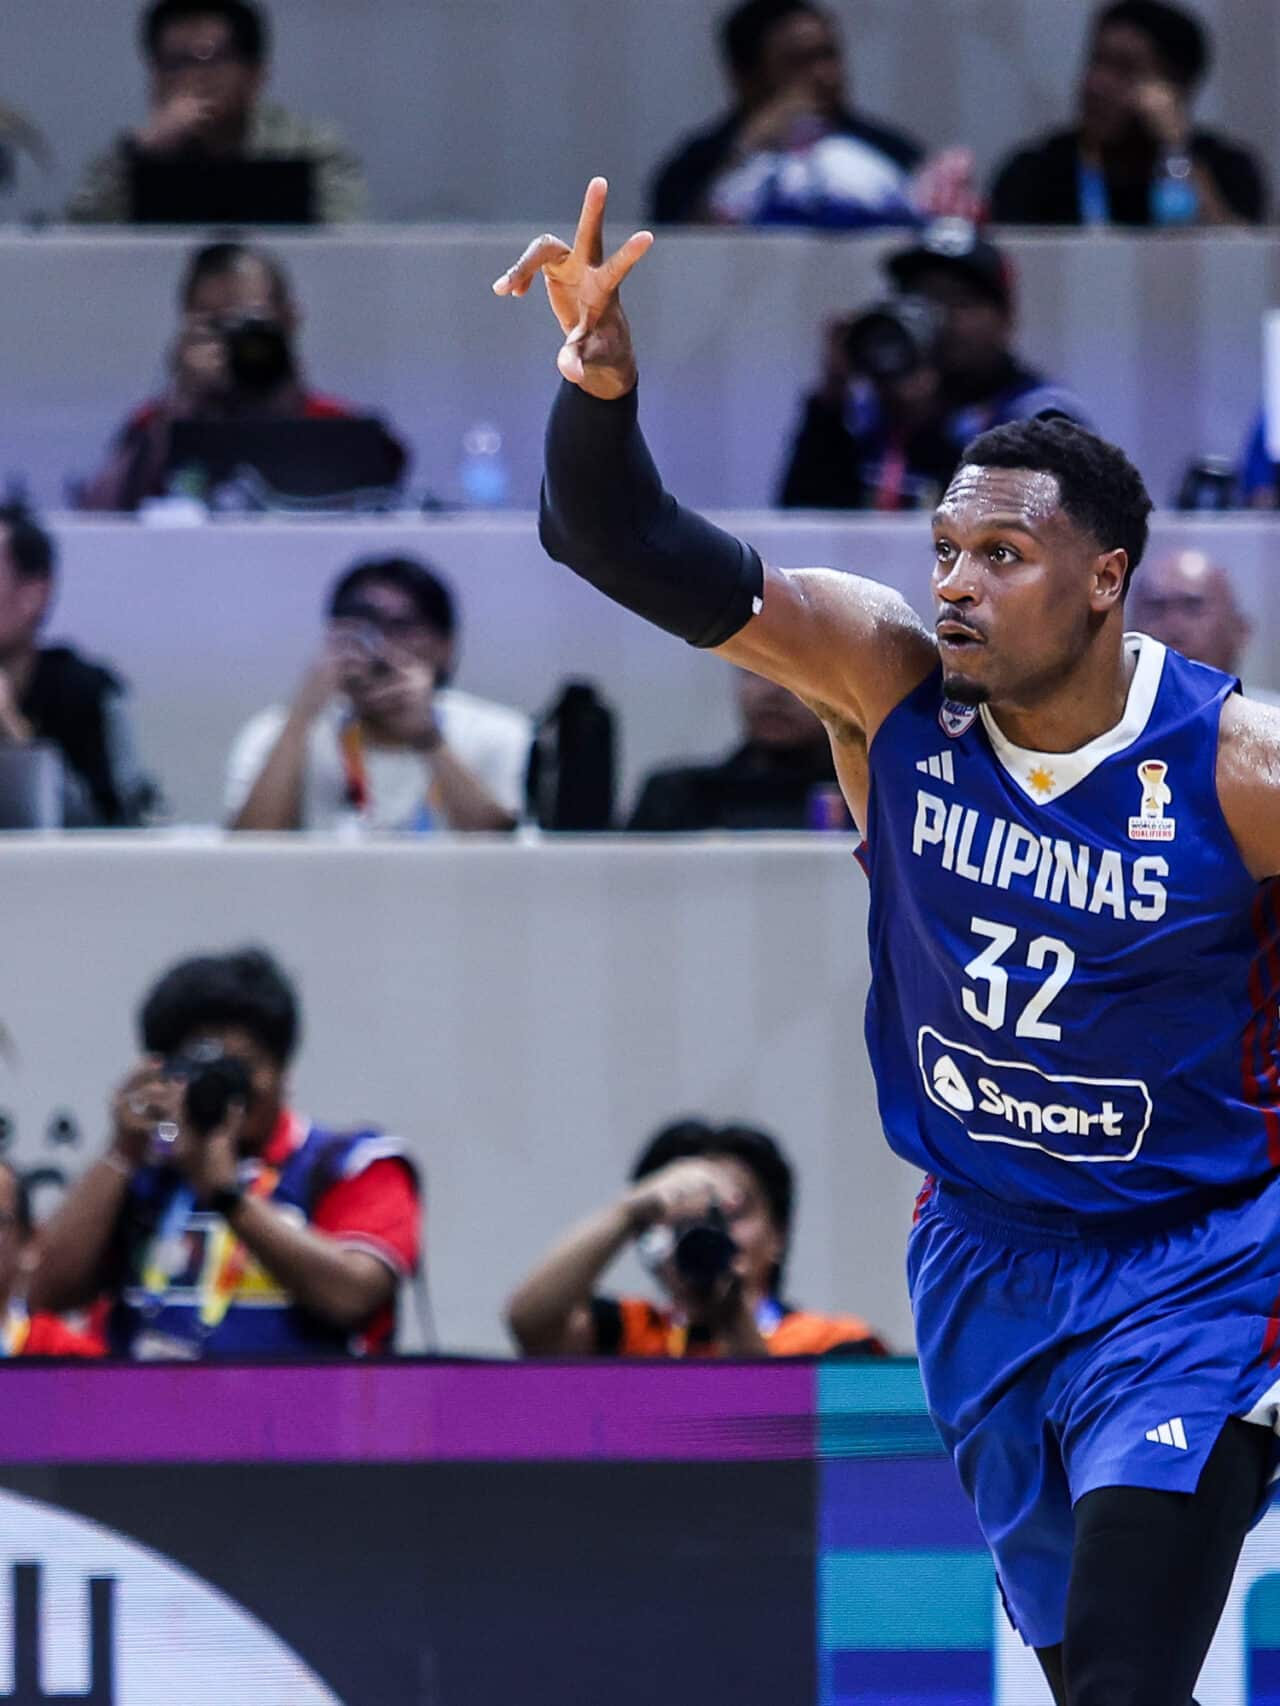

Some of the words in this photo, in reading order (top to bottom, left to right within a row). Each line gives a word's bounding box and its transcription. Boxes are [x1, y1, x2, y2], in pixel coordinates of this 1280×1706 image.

[912, 789, 1169, 922] PILIPINAS
[1130, 830, 1173, 838] QUALIFIERS
[961, 916, 1076, 1042] 32
[977, 1077, 1124, 1137] Smart
